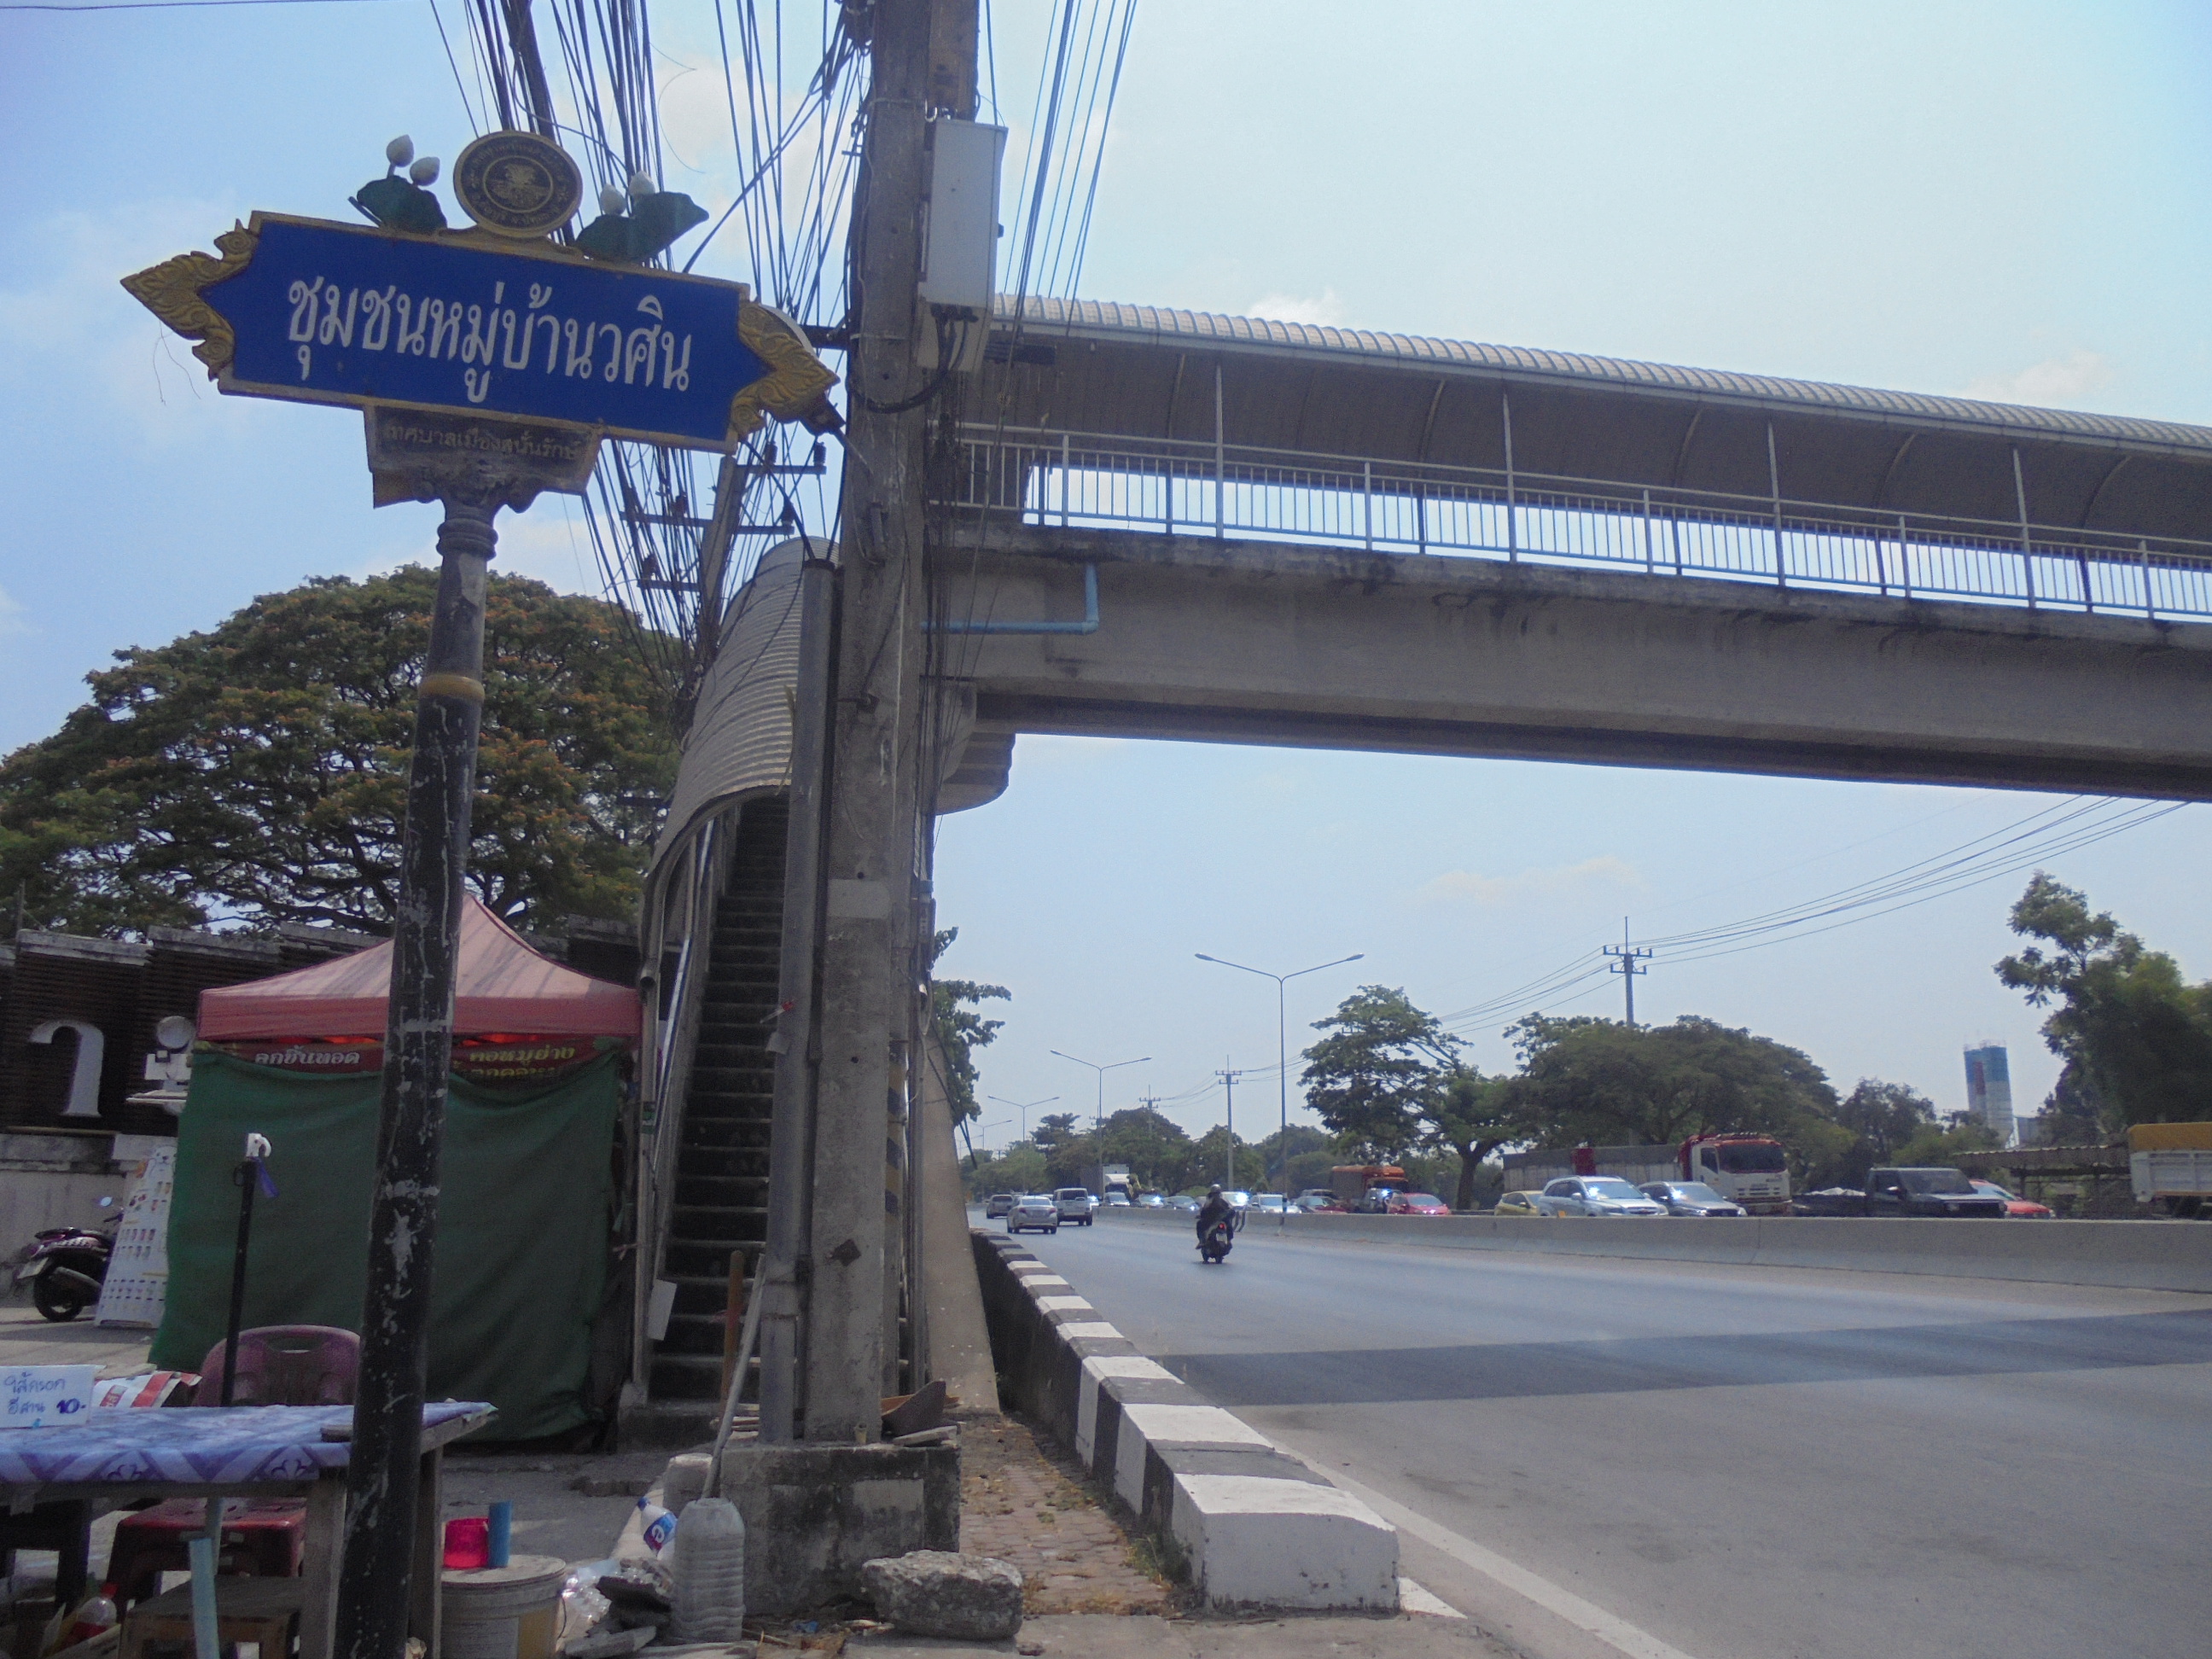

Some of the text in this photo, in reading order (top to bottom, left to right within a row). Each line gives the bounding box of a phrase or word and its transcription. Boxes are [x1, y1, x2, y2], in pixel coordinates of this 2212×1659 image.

[288, 276, 692, 404] ชุมชนหมู่บ้านวศิน
